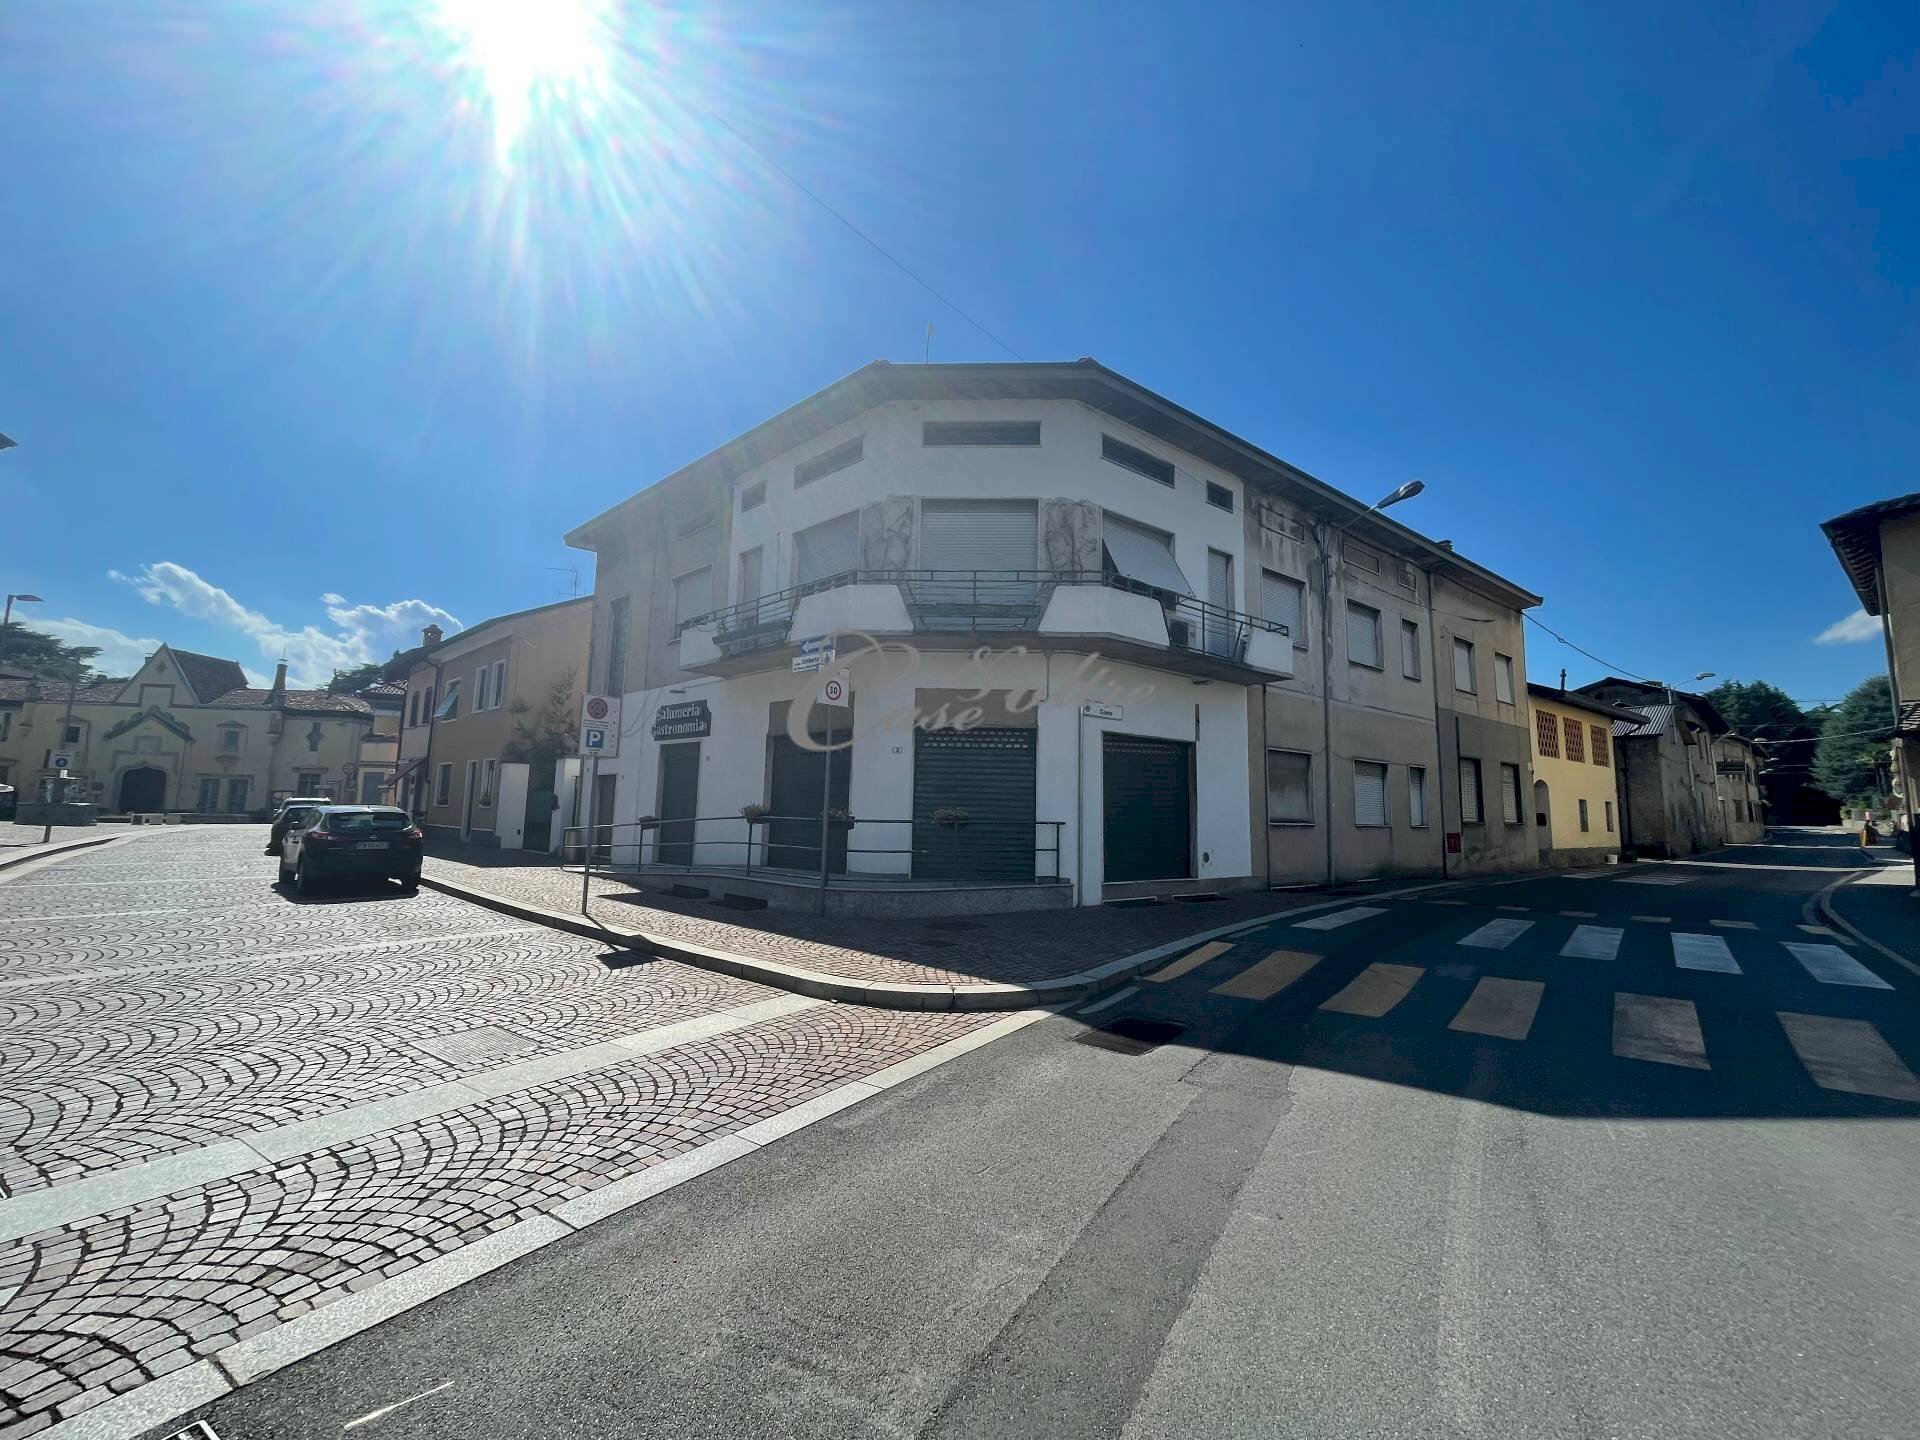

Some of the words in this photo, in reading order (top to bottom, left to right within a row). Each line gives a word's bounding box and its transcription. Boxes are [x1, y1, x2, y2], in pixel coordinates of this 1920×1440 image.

[829, 686, 838, 695] 30
[656, 703, 700, 721] Salumeria
[651, 718, 705, 735] Gastronomia
[589, 730, 601, 746] P
